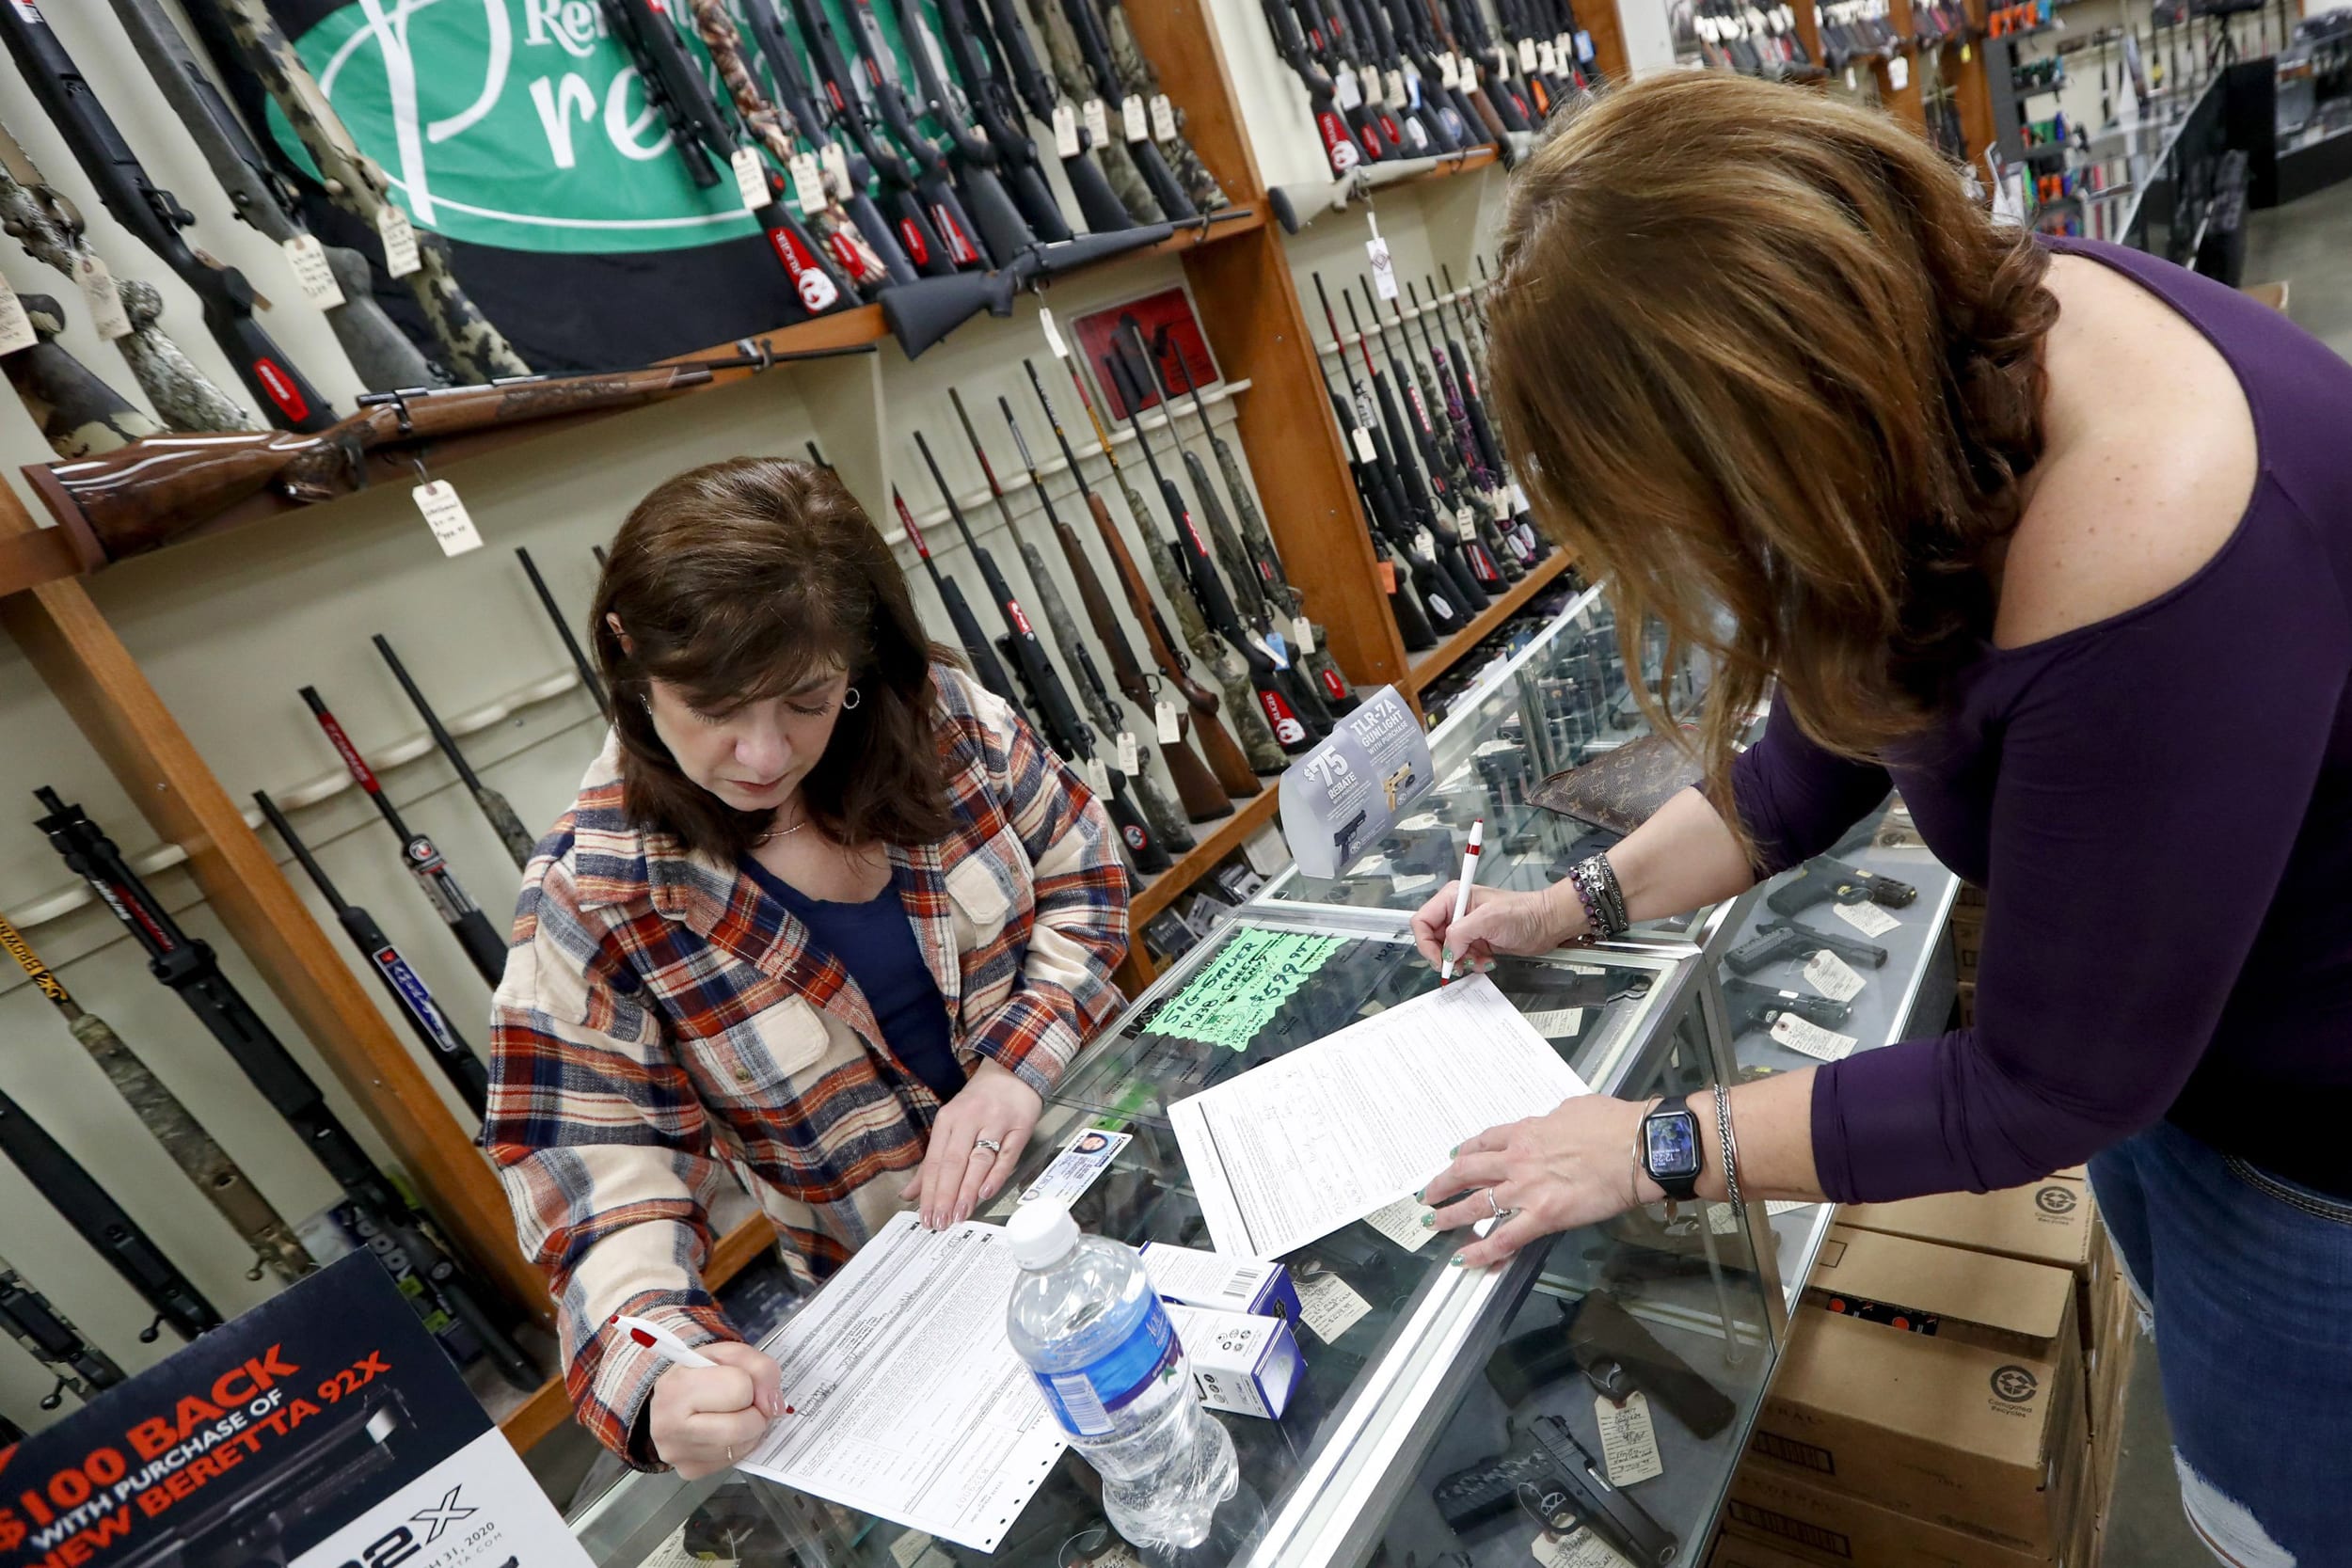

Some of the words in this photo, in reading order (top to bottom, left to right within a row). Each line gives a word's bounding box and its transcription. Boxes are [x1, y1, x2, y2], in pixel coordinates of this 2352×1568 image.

[775, 230, 801, 276] RUGER
[1264, 692, 1281, 721] RUGER
[1350, 699, 1397, 736] TLR-7A
[1361, 709, 1404, 748] GUNLIGHT
[1368, 742, 1382, 755] WITH
[1381, 721, 1409, 748] PURCHASE
[1303, 745, 1349, 788] $75
[1327, 771, 1358, 800] REBATE
[1650, 1151, 1674, 1164] 12:25
[0, 1446, 127, 1552] $100
[126, 1343, 300, 1462] BACK
[135, 1398, 321, 1518] BERETTA
[318, 1349, 392, 1404] 92X
[30, 1495, 114, 1550] WITH
[114, 1411, 246, 1501] PURCHASE
[249, 1388, 284, 1418] OF
[464, 1522, 496, 1547] 2020
